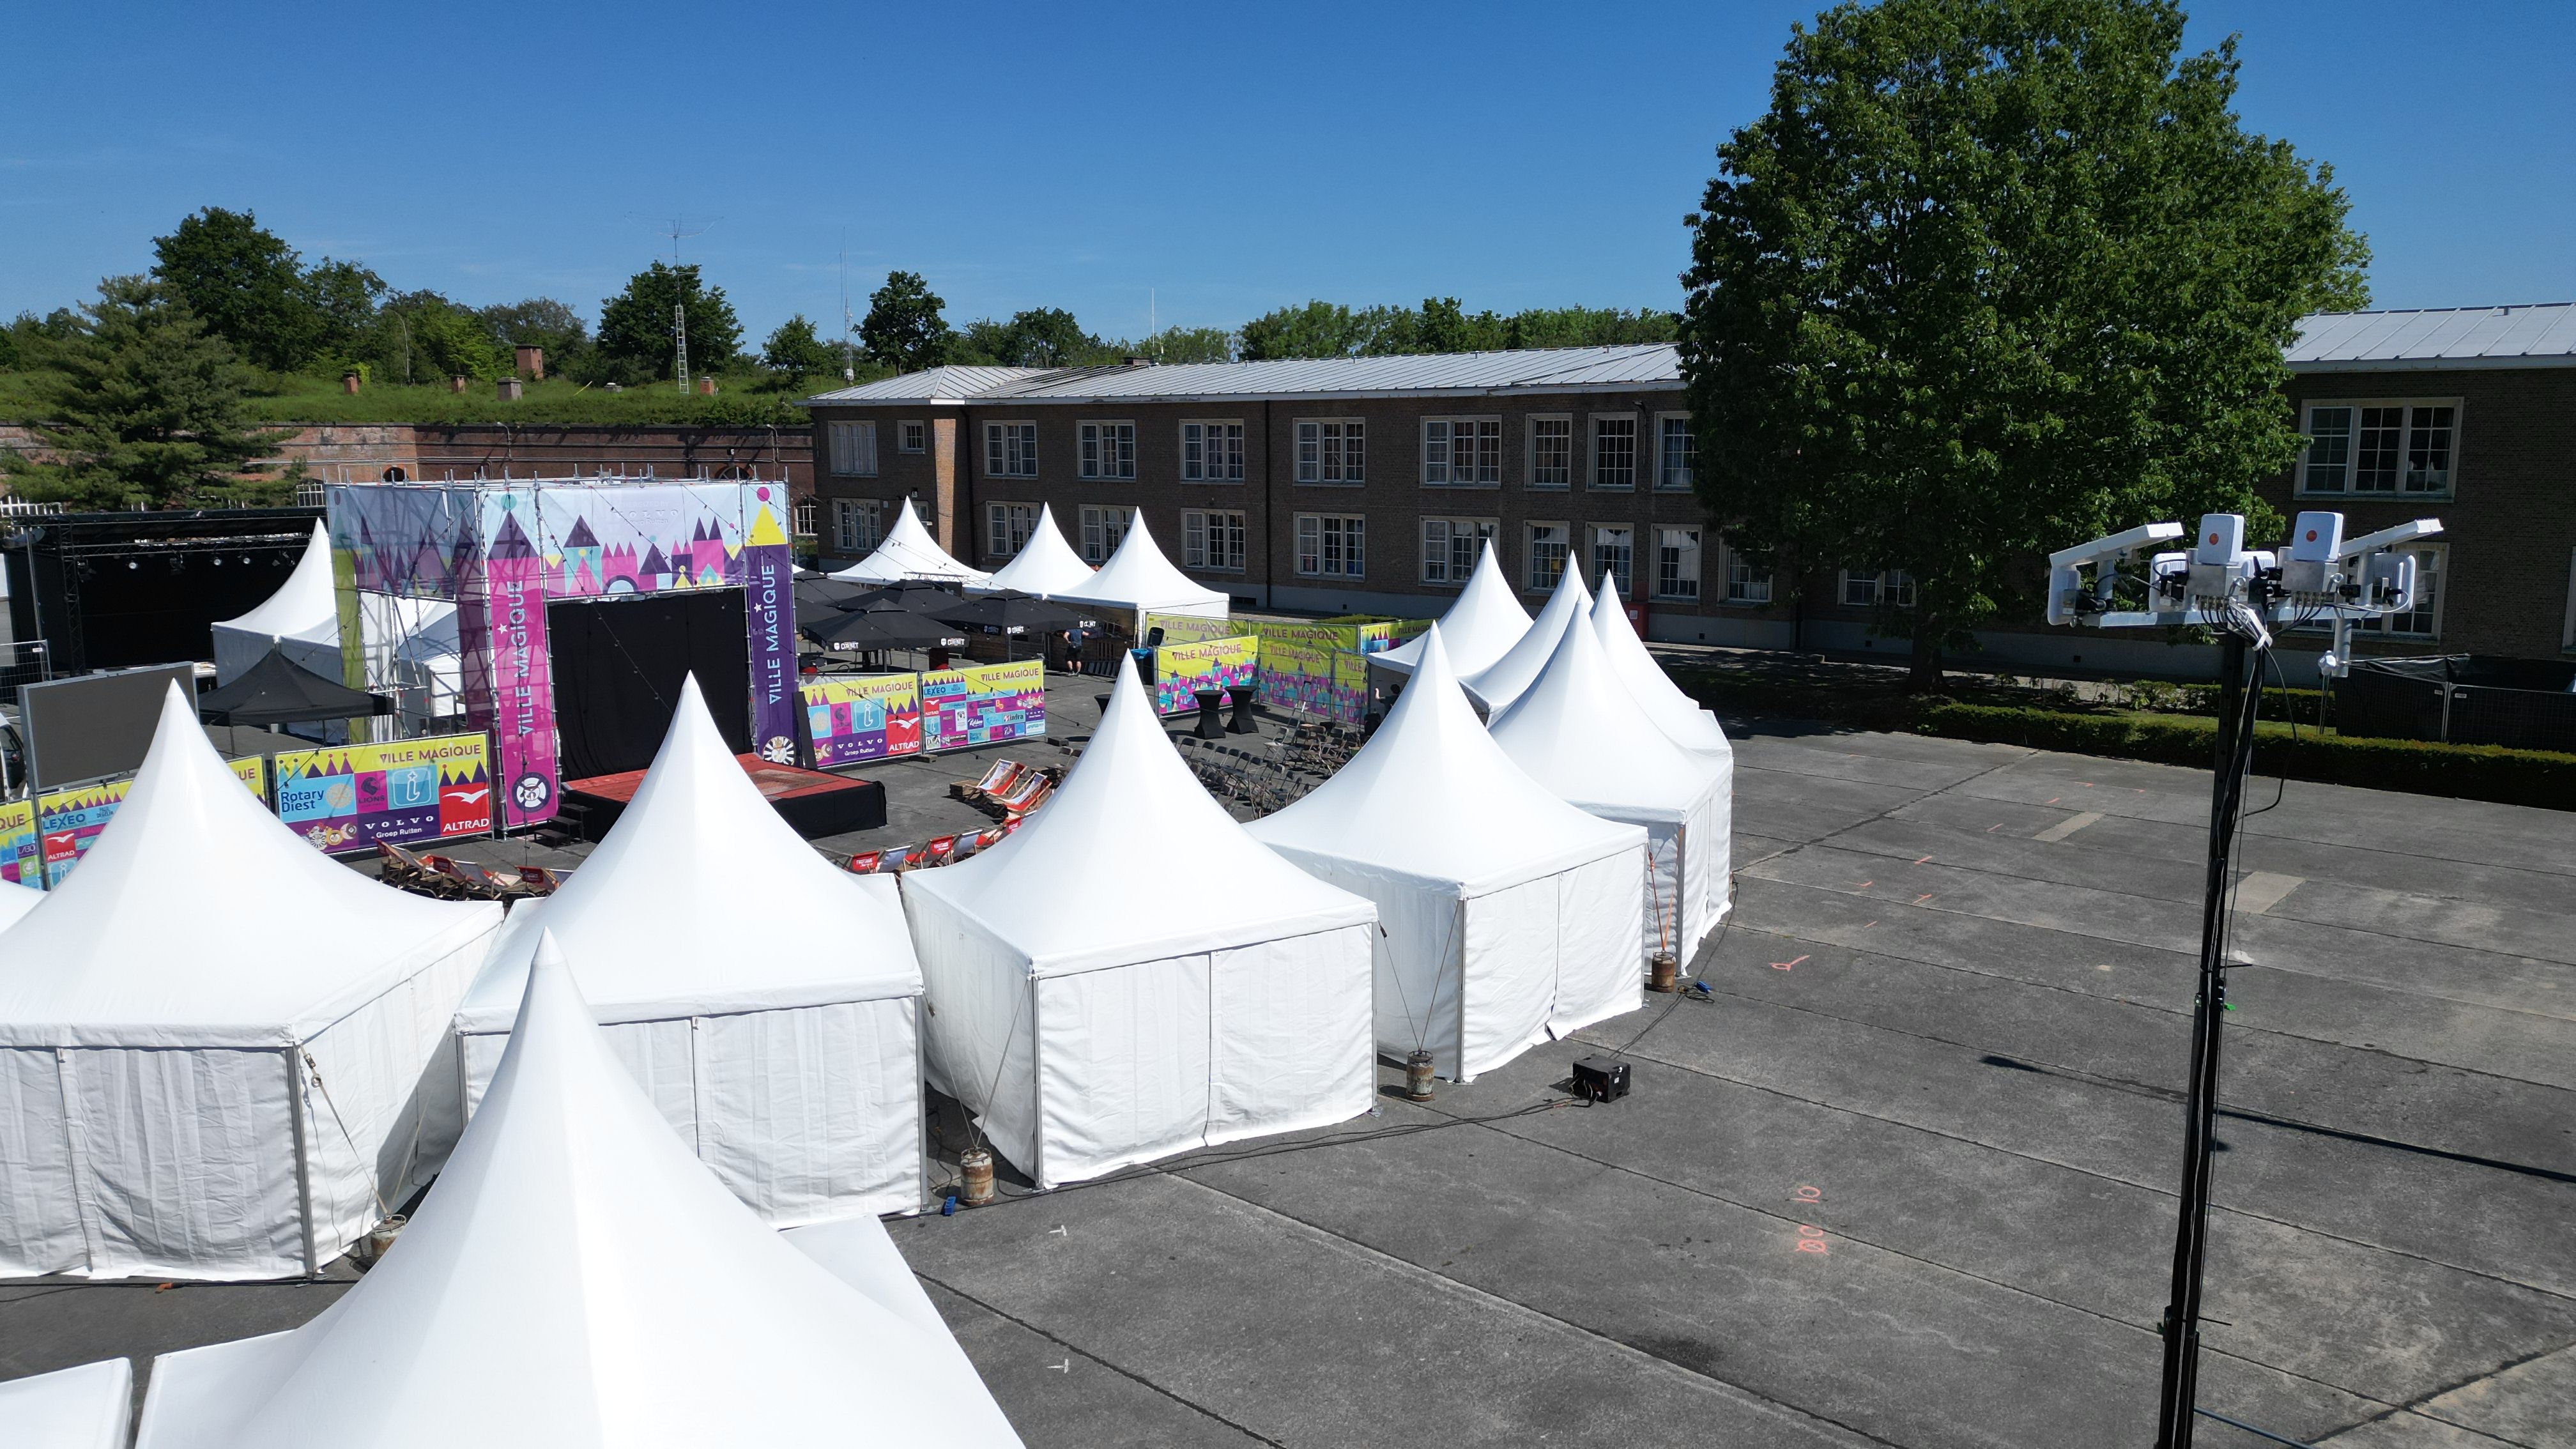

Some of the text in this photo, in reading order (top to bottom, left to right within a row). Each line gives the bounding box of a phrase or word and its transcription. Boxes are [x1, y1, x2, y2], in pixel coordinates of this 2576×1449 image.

[761, 564, 782, 704] VILLE MAGIQUE
[1160, 620, 1230, 634] VILLE MAGIQUE
[1263, 628, 1338, 641] VILLE MAGIQUE
[507, 580, 534, 735] VILLE MAGIQUE
[1173, 644, 1242, 661] VILLE MAGIQUE
[1269, 645, 1320, 663] VILLE MAGIQUE
[1344, 659, 1362, 671] VILLE
[981, 668, 1039, 682] VILLE MAGIQUE
[846, 681, 913, 697] VILLE MAGIQUE
[924, 686, 946, 696] LEXEO
[837, 739, 882, 749] VOLVO
[889, 740, 919, 752] ALTRAD
[379, 744, 481, 763] VILLE MAGIQUE
[281, 790, 324, 802] Rotary
[282, 799, 316, 813] Diest
[43, 813, 86, 830] LEXEO
[365, 815, 434, 829] VOLVO
[443, 818, 489, 832] ALTRAD
[376, 829, 397, 838] Groep
[48, 850, 75, 861] ALTRAD
